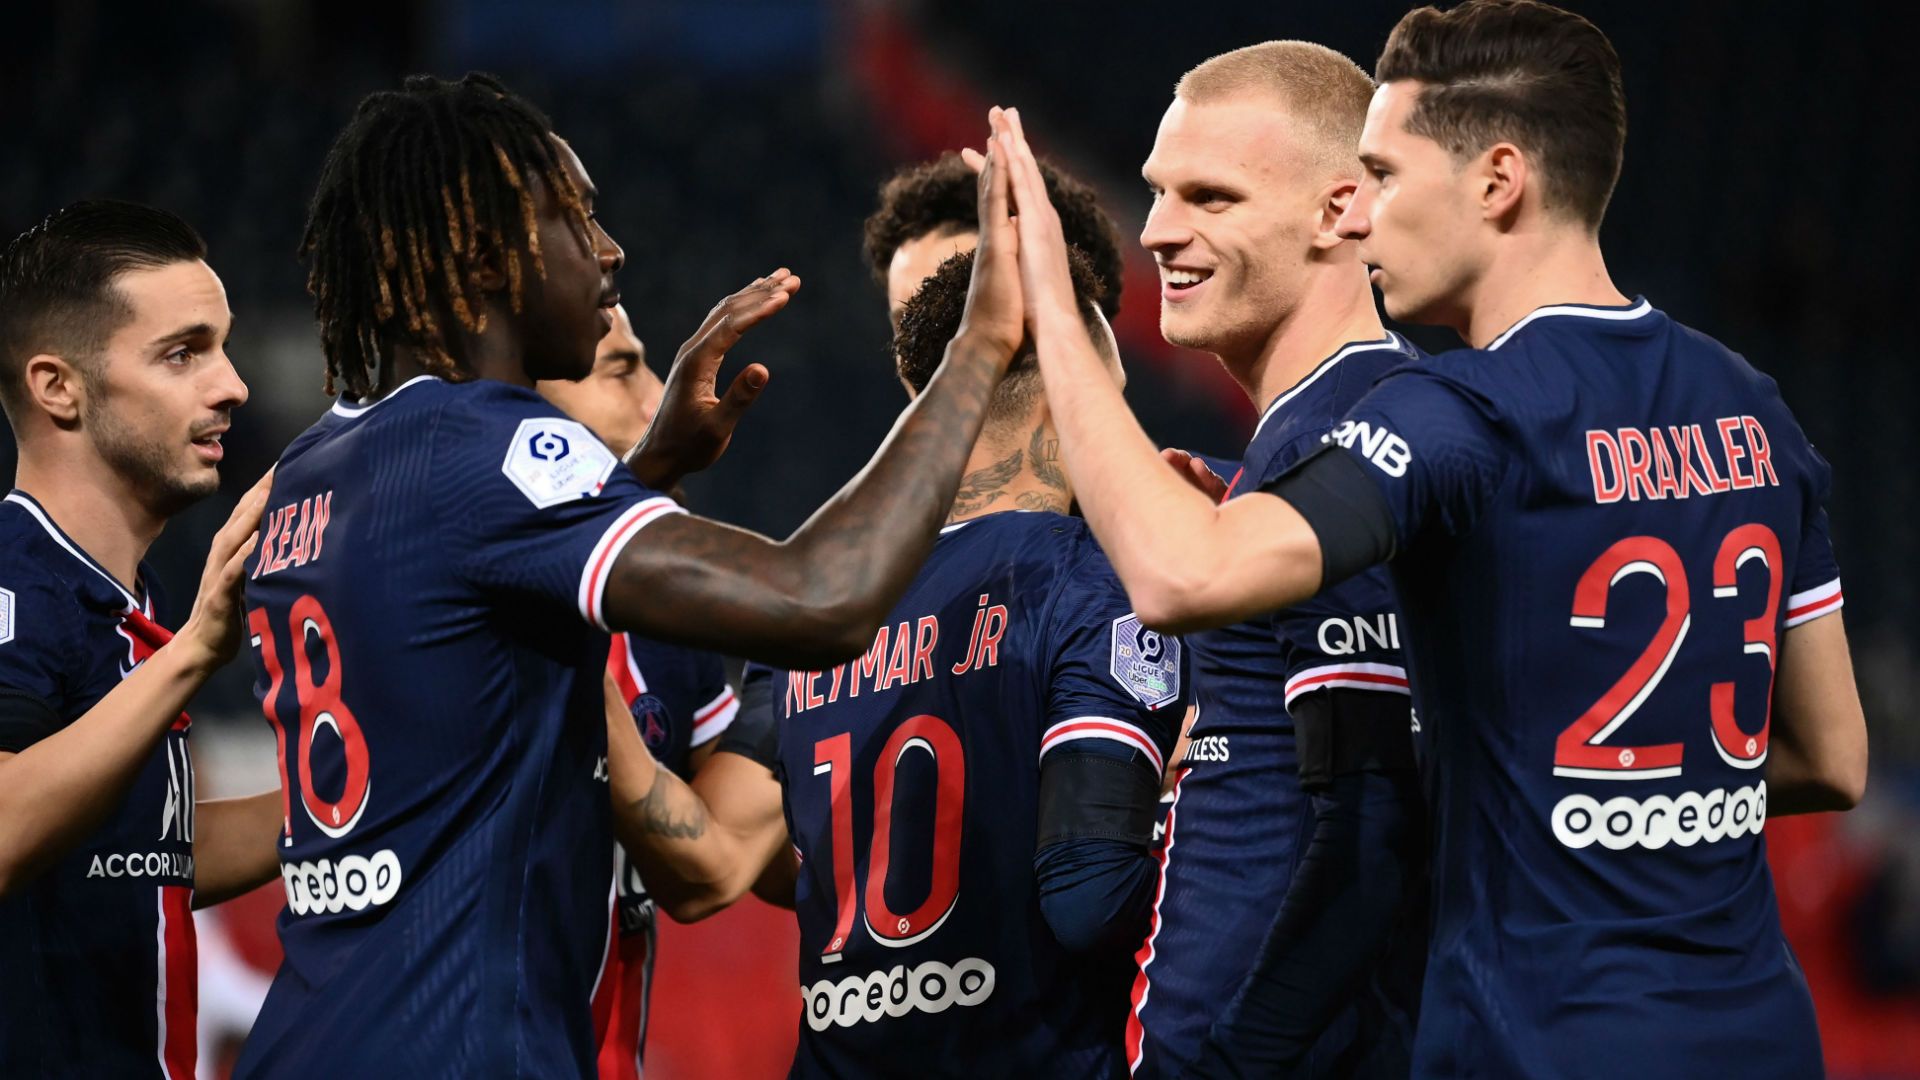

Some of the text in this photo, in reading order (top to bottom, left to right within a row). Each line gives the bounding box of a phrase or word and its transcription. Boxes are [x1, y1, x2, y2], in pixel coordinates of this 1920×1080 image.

[1585, 415, 1779, 504] DRAXLER
[251, 490, 333, 580] KEAN
[785, 614, 939, 719] NEYMAR
[1553, 522, 1783, 781] 23
[247, 594, 371, 847] 18
[813, 714, 965, 964] 10
[1551, 780, 1767, 850] ooredoo
[86, 852, 170, 878] ACCOR
[801, 957, 996, 1032] oredoo
